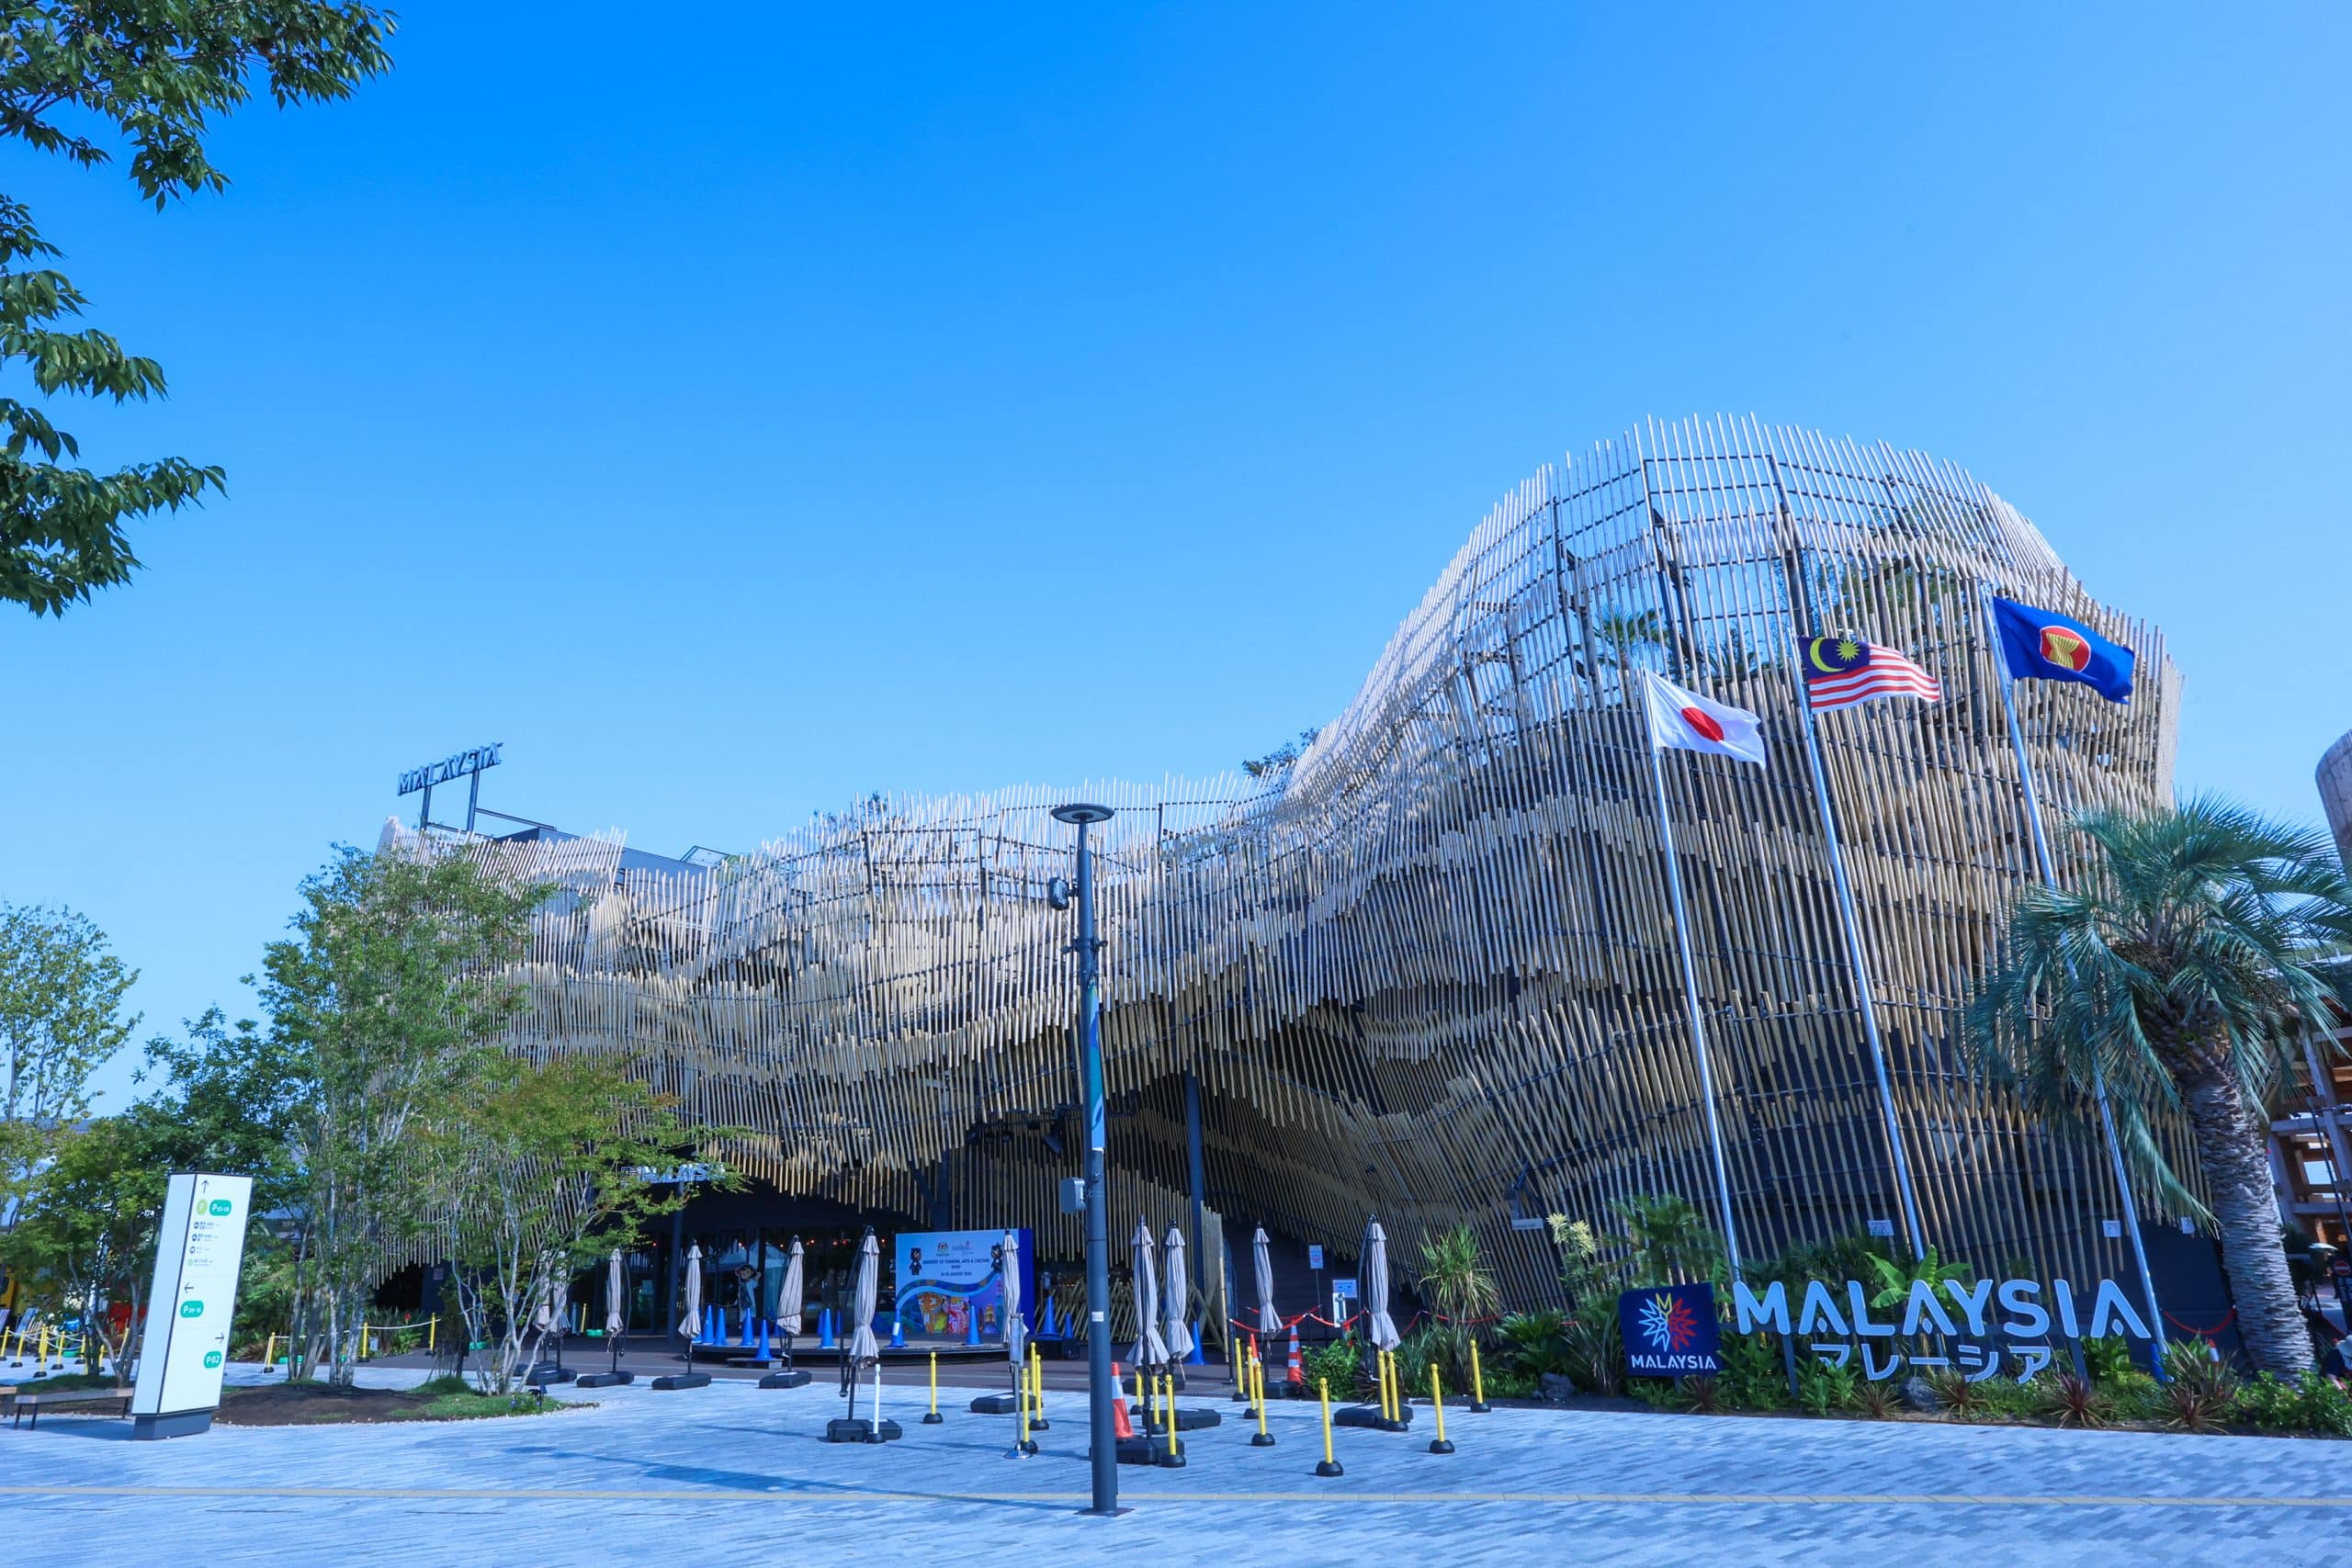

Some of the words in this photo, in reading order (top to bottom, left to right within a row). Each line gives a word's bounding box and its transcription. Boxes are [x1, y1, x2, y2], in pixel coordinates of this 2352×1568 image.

[397, 742, 501, 796] MALAYSIA
[1733, 1279, 2152, 1339] MALAYSIA
[1630, 1354, 1718, 1370] MALAYSIA
[1811, 1343, 2052, 1385] マレーシア
